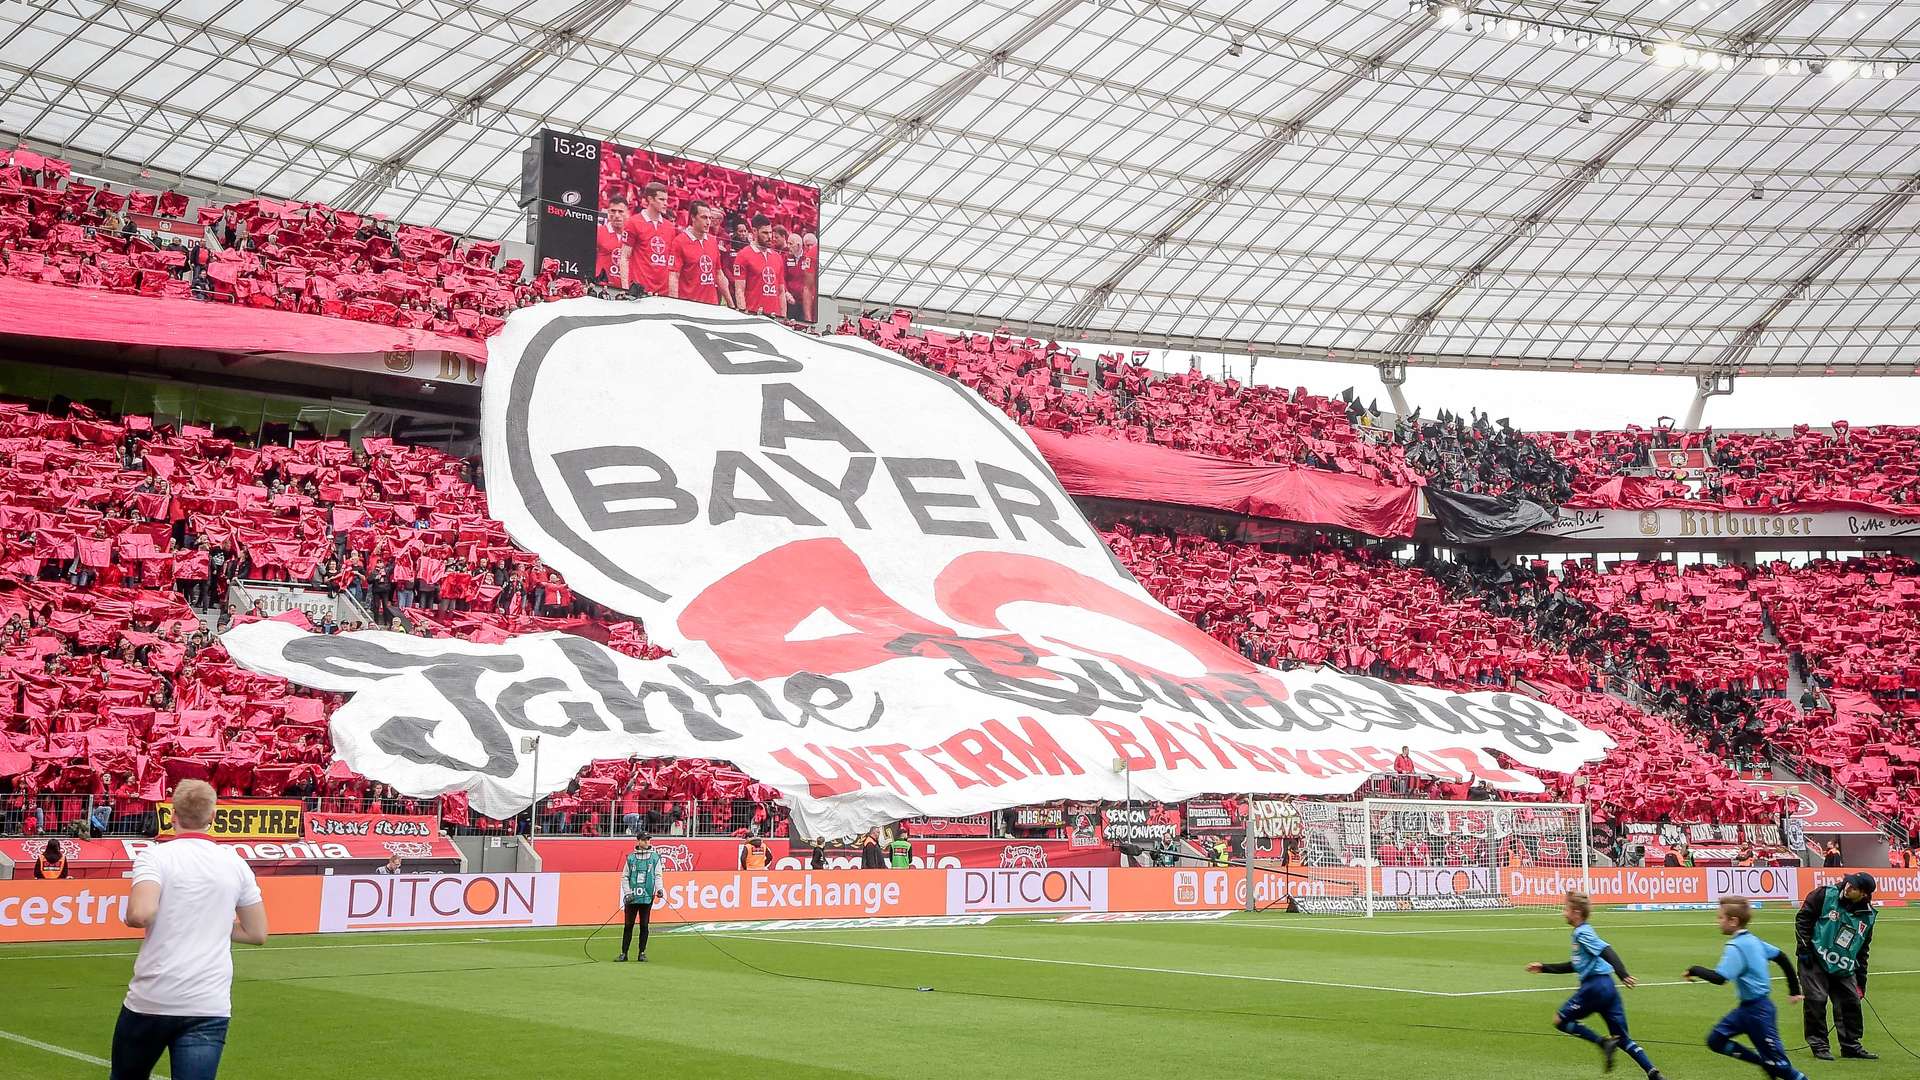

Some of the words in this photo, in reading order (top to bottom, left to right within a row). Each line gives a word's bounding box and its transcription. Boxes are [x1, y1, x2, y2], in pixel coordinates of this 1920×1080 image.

[552, 137, 597, 160] 15:28
[547, 205, 594, 222] BayArena
[700, 273, 714, 283] 04
[762, 284, 777, 294] 04
[552, 446, 1086, 548] BAYER
[1680, 508, 1814, 536] Bitburger
[1848, 516, 1885, 535] Bitte
[282, 634, 885, 778] Jahre
[158, 807, 299, 834] CSSFIRE
[620, 874, 741, 912] osted
[751, 875, 900, 914] Exchange
[964, 871, 1092, 904] DITCON
[1396, 869, 1489, 897] DITCON
[1627, 871, 1700, 900] Kopierer
[1716, 869, 1790, 895] DITCON
[347, 876, 536, 919] DITCON
